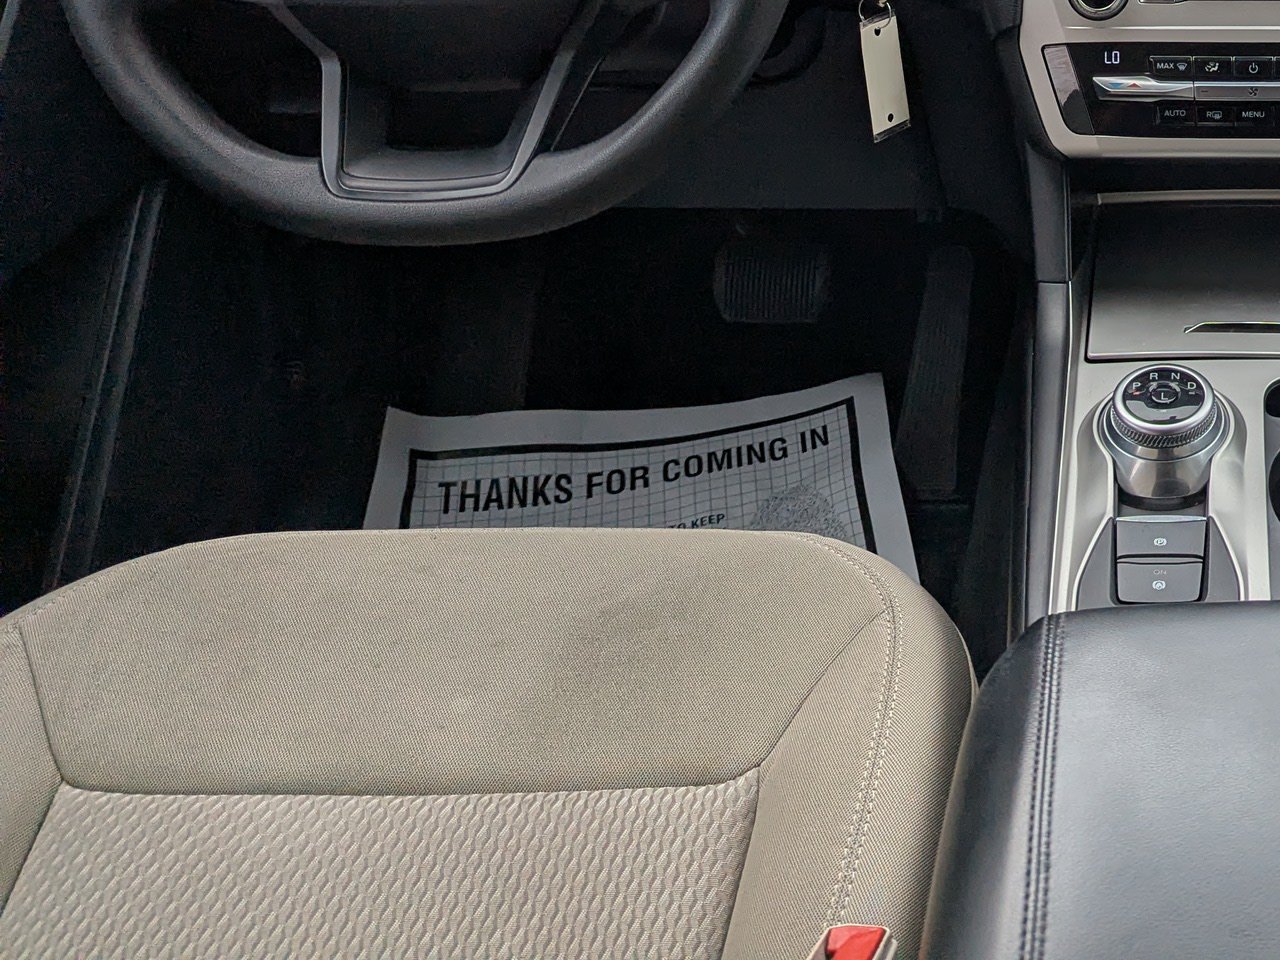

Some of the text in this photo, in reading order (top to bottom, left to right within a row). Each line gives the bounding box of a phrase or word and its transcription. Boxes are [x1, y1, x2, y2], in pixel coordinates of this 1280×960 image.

[1104, 50, 1120, 64] LO
[1156, 62, 1174, 70] MAX
[1164, 109, 1186, 117] AUTO
[1242, 110, 1265, 118] MENU
[1149, 372, 1159, 380] R
[1171, 372, 1180, 380] N
[1132, 381, 1141, 390] P
[1187, 381, 1197, 390] D
[1160, 392, 1168, 401] L
[438, 424, 830, 515] THANKS FOR COMING IN
[690, 513, 726, 529] KEEP
